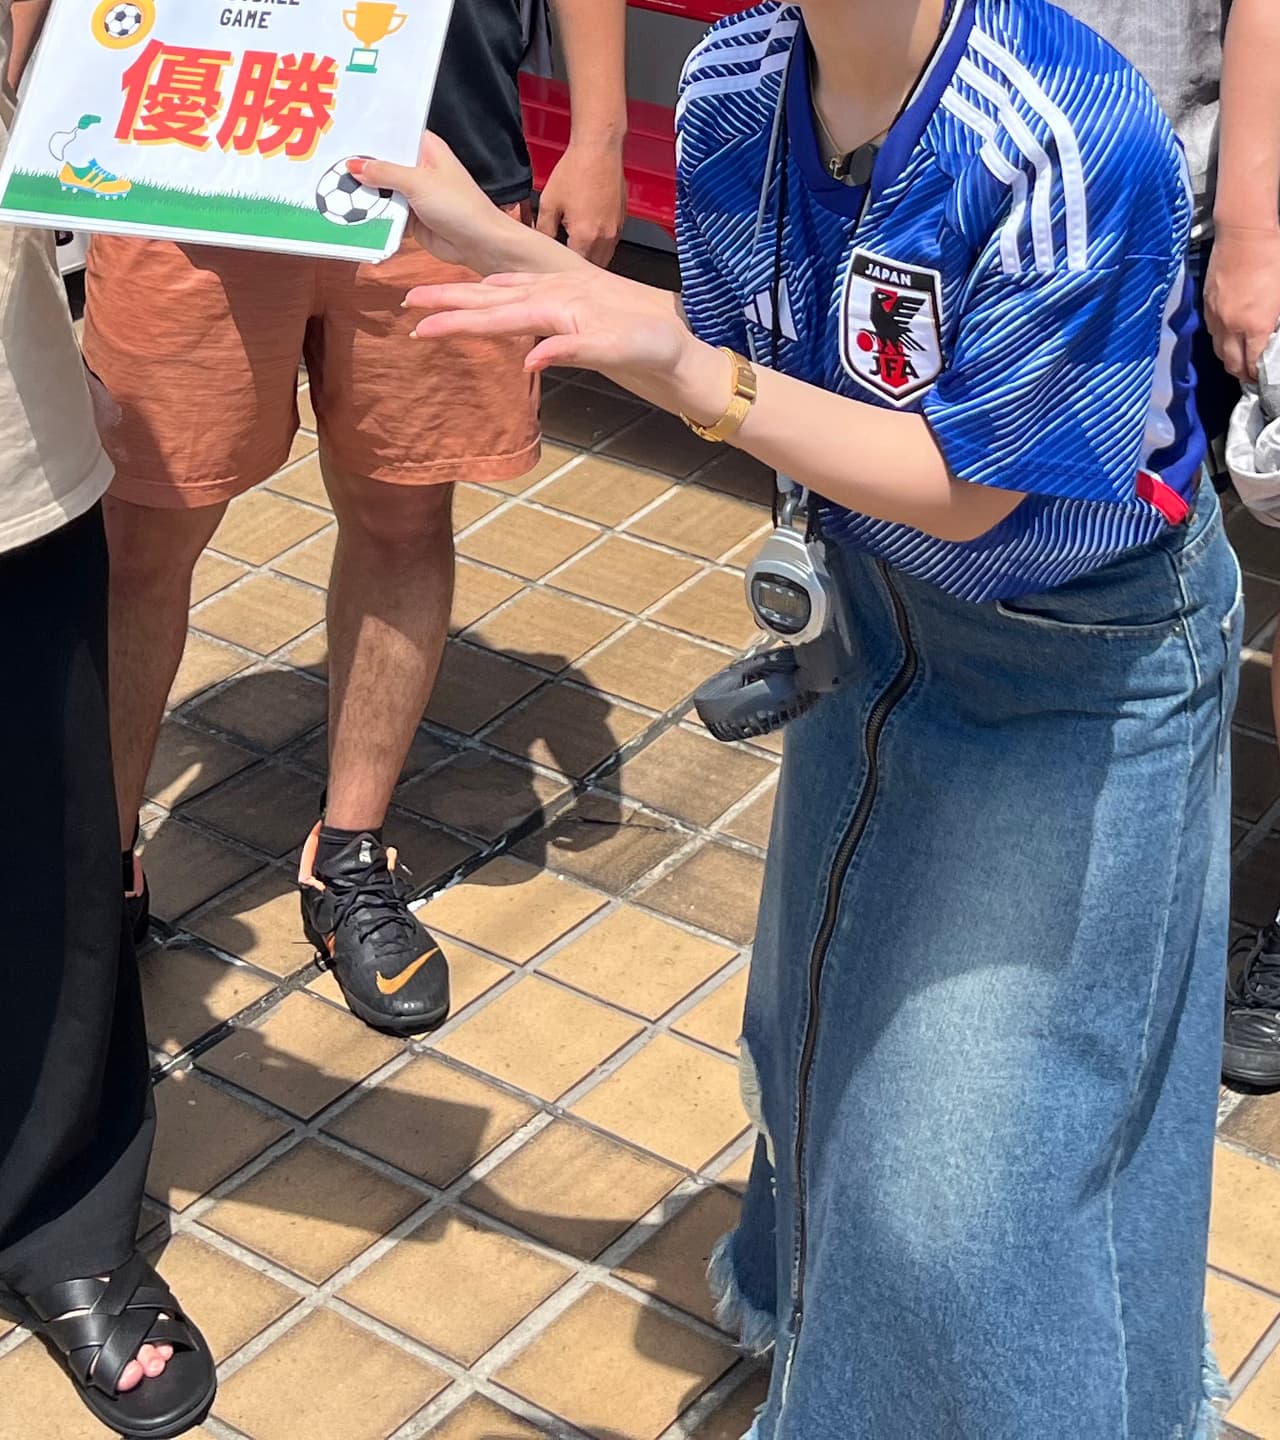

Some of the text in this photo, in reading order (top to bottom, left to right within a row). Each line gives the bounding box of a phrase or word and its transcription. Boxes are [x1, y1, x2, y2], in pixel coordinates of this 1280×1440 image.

[219, 7, 273, 30] GAME
[114, 38, 339, 162] 優勝
[864, 263, 912, 287] JAPAN
[869, 355, 921, 379] JFA
